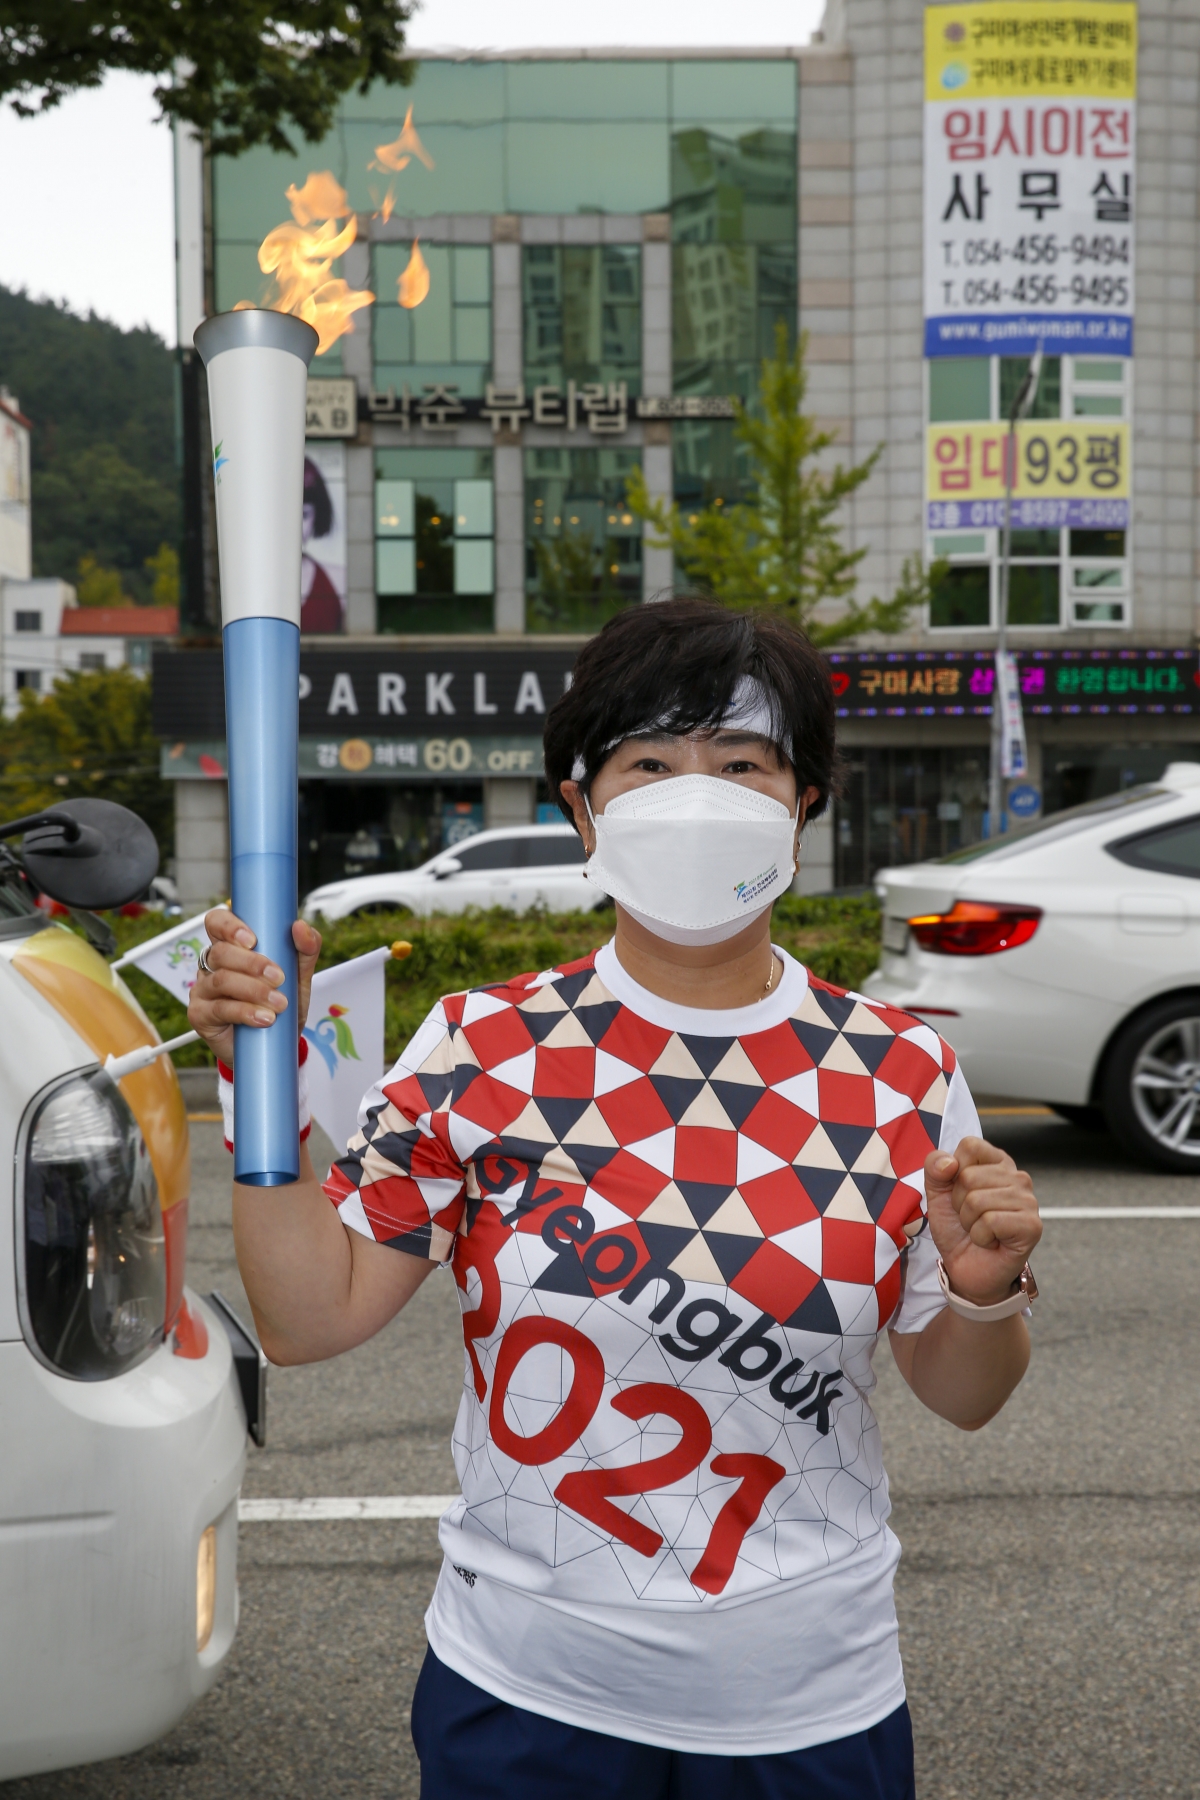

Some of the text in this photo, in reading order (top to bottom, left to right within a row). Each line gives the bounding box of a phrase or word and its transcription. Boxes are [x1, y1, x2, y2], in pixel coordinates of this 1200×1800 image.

[943, 107, 1131, 162] 임시이전
[963, 234, 1130, 266] 054-456-9494
[963, 275, 1129, 307] 054-456-9495
[939, 318, 1130, 342] www.gumiwoman.or.kr
[306, 409, 348, 429] AB
[367, 379, 628, 435] 박준 뷰티랩
[934, 433, 1120, 491] 임대 93평
[299, 672, 573, 716] ARKLA
[858, 668, 960, 696] 구미사랑
[968, 667, 1046, 695] 상권
[487, 748, 533, 771] OFF
[474, 1145, 843, 1436] Gyeongbuk
[453, 1248, 787, 1596] 2021
